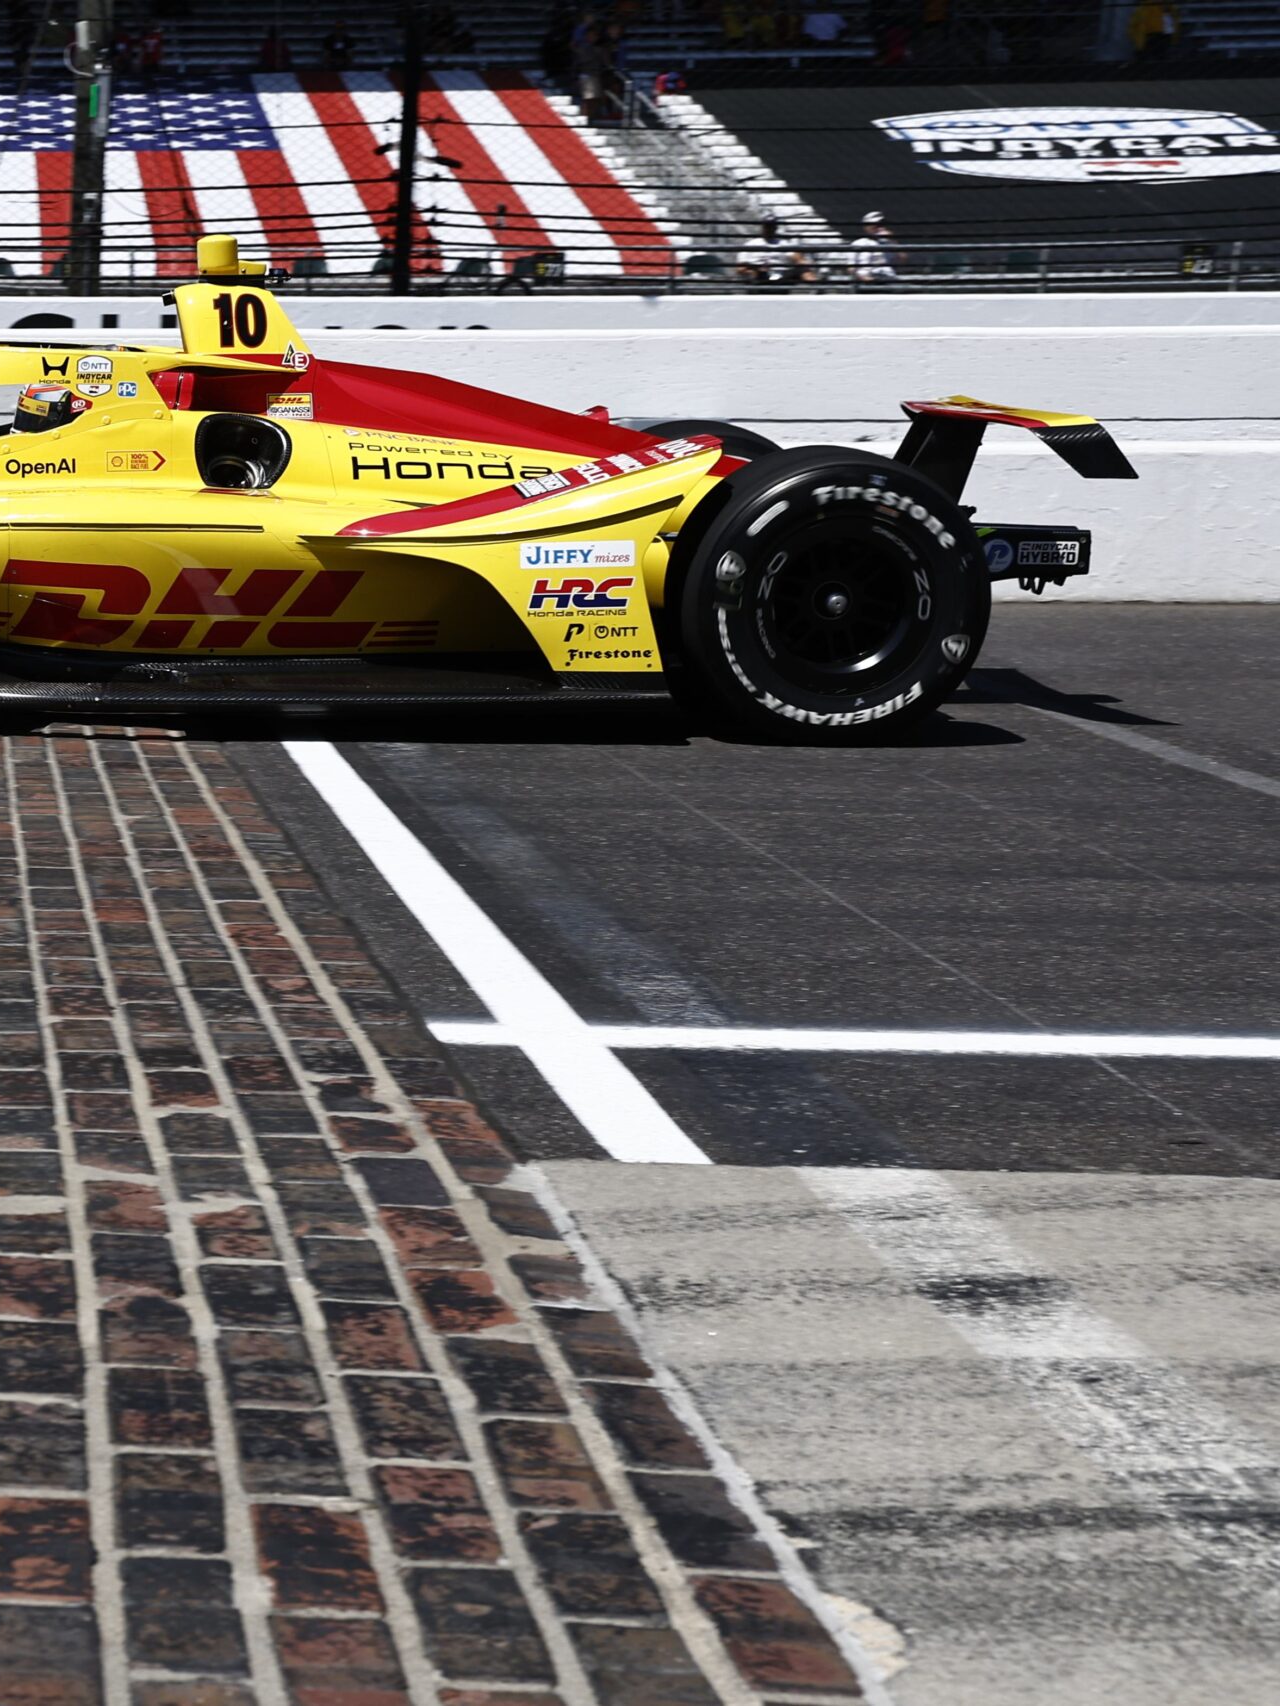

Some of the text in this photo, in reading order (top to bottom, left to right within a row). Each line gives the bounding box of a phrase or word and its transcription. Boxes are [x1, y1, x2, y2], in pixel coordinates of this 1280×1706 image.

[912, 134, 1280, 154] INDYCAR
[998, 146, 1211, 158] SERIES
[213, 293, 268, 349] 10
[119, 383, 136, 396] PPG
[274, 396, 305, 404] DHL
[348, 442, 514, 462] Powered by
[5, 458, 76, 478] OpenAI
[351, 456, 553, 480] Honda
[812, 486, 956, 549] Firestone
[595, 552, 630, 563] mixes
[528, 577, 634, 609] HRC
[0, 559, 377, 648] DHL
[611, 626, 639, 637] NTT
[568, 649, 652, 661] Firestone
[756, 681, 923, 726] FIREHAWK
